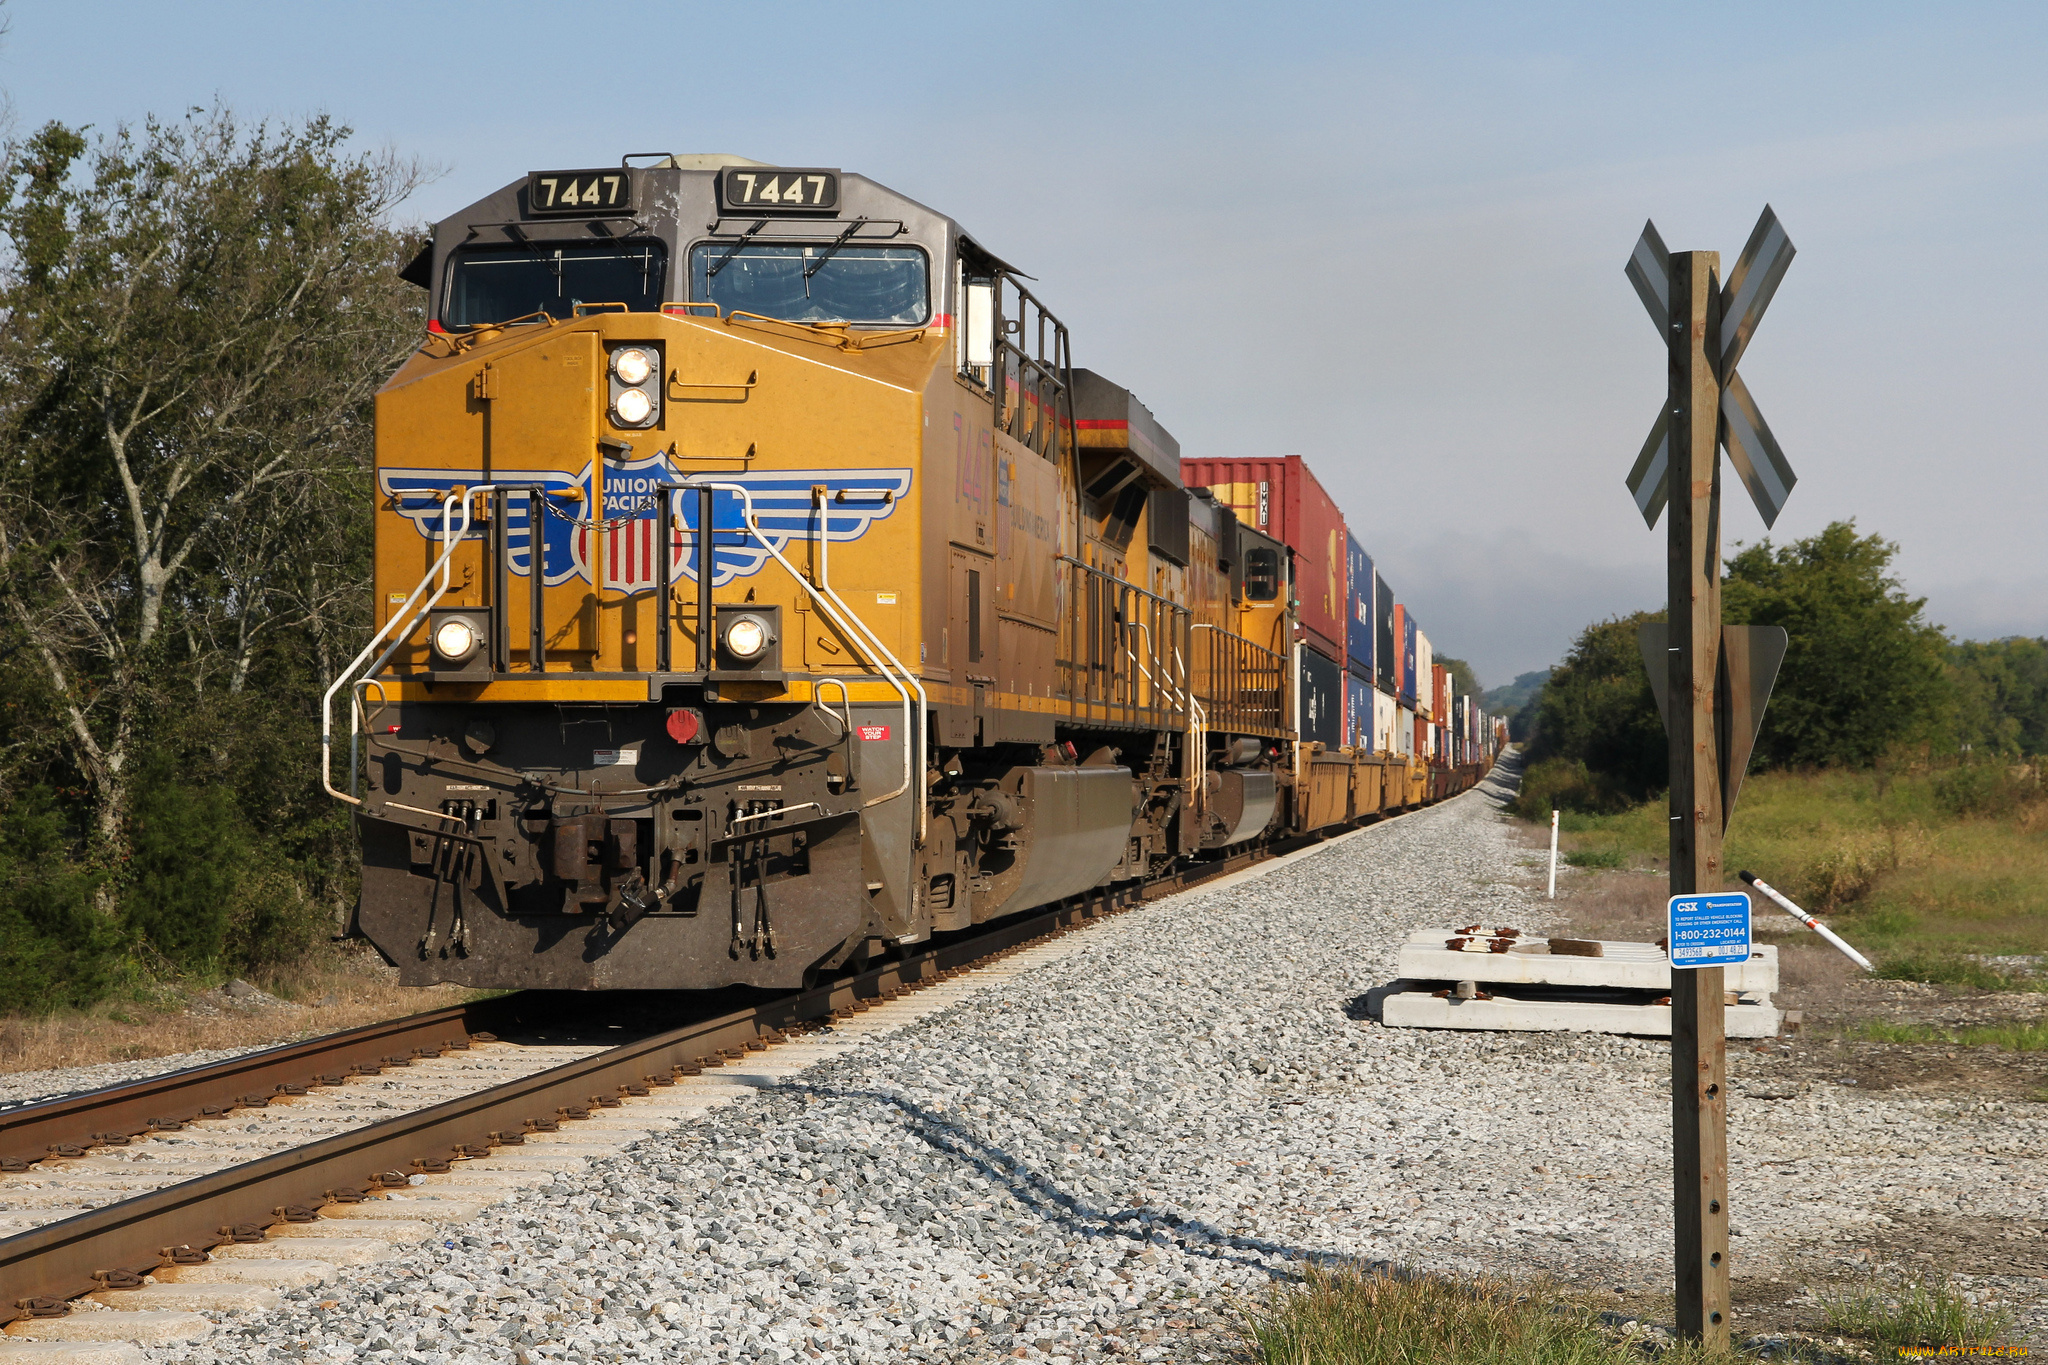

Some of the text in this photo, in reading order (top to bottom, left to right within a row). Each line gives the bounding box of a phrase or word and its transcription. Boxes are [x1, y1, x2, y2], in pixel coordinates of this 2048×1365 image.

[540, 175, 622, 207] 7447
[736, 173, 827, 204] 7447
[602, 477, 662, 494] UNION
[1677, 902, 1698, 912] CSX
[1675, 928, 1745, 940] 1-800-232-0144
